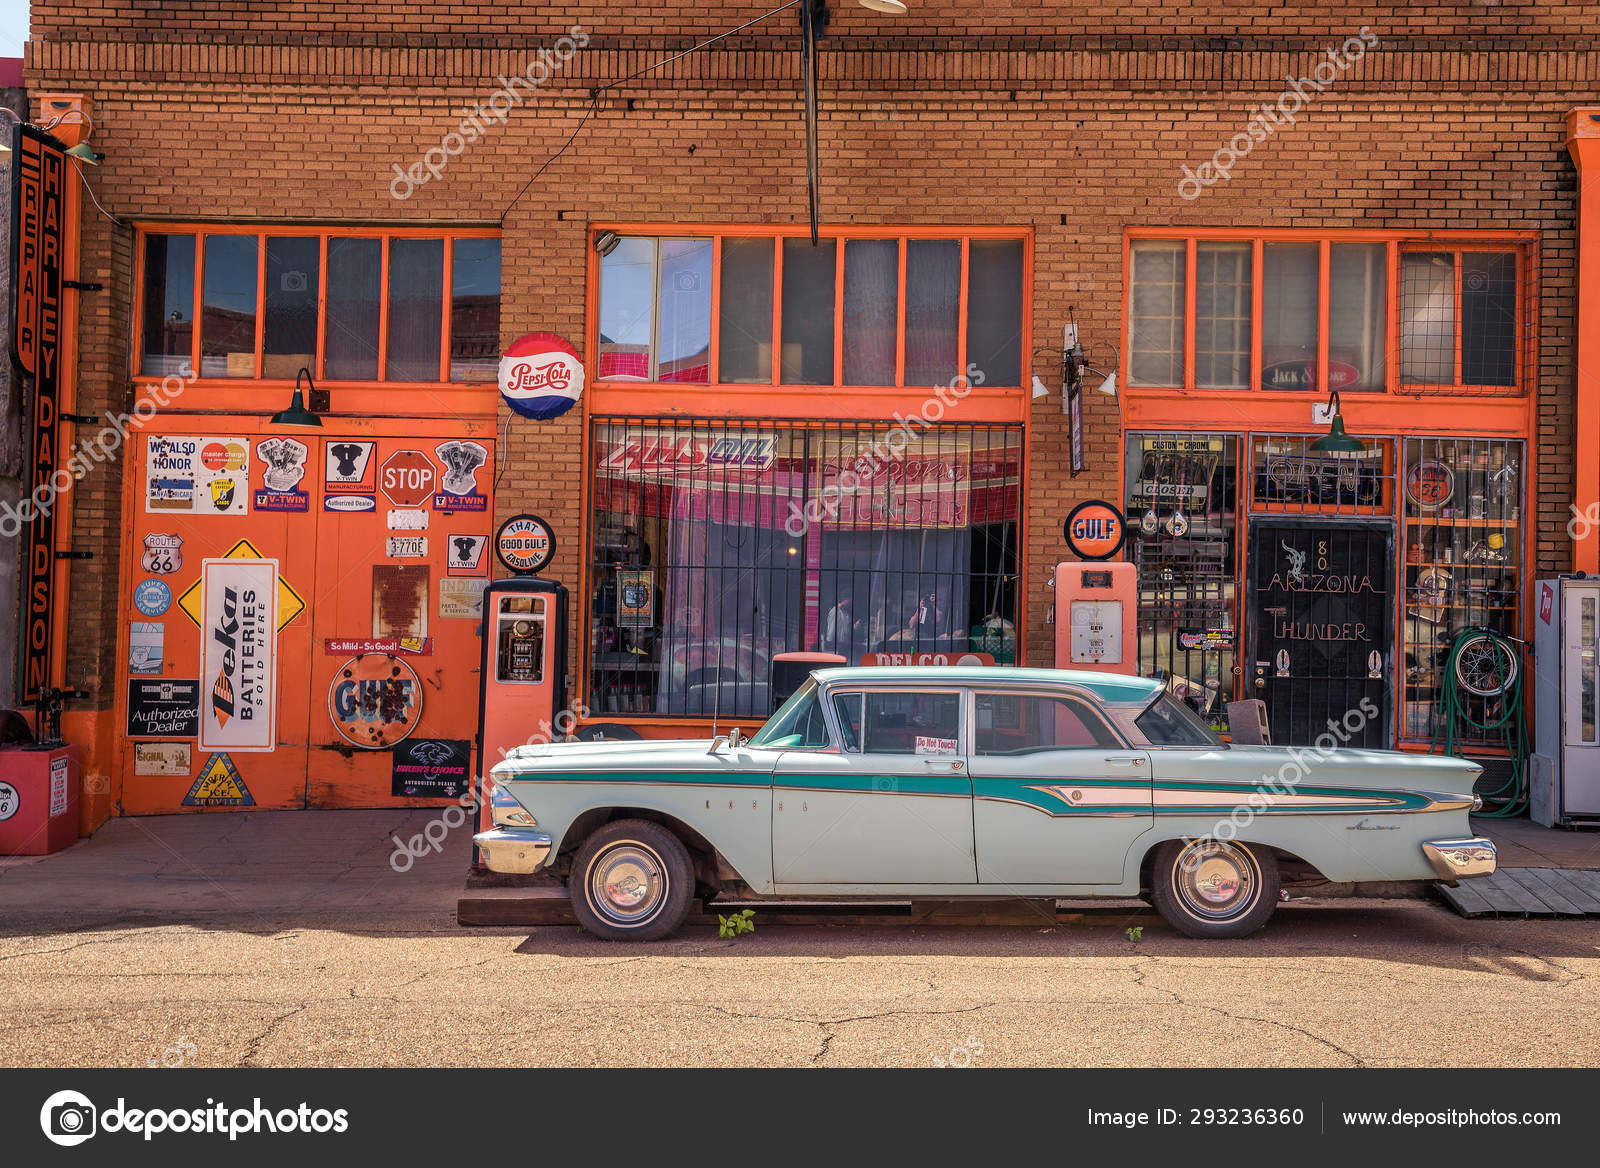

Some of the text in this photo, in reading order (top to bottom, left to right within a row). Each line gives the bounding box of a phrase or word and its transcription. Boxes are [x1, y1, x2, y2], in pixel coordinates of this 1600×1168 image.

[21, 183, 37, 353] REPAIR
[30, 153, 59, 688] HARLEY DAVIDSON
[150, 441, 196, 454] WE ALSO
[153, 457, 191, 470] HONOR
[384, 467, 433, 490] STOP
[269, 495, 306, 504] V-TWIN
[448, 496, 485, 505] V-TWIN
[508, 521, 539, 533] THAT
[1072, 518, 1117, 541] GULF
[150, 537, 177, 547] ROUTE
[500, 538, 548, 550] GOOD GULF
[150, 556, 173, 572] 66
[505, 552, 543, 568] GASOLINE
[1259, 572, 1383, 594] ARIZONA
[1263, 607, 1373, 642] THUNDER
[331, 641, 341, 650] So
[342, 641, 359, 650] Mild
[364, 641, 374, 650] So
[375, 641, 397, 650] Good!
[240, 590, 256, 721] BATTERIES
[256, 602, 266, 706] SOLD HERE
[875, 653, 949, 666] DELCO
[132, 706, 199, 722] Authorized
[147, 718, 188, 734] Dealer
[917, 737, 956, 749] Do Not Touch!
[430, 765, 465, 775] CHOICE
